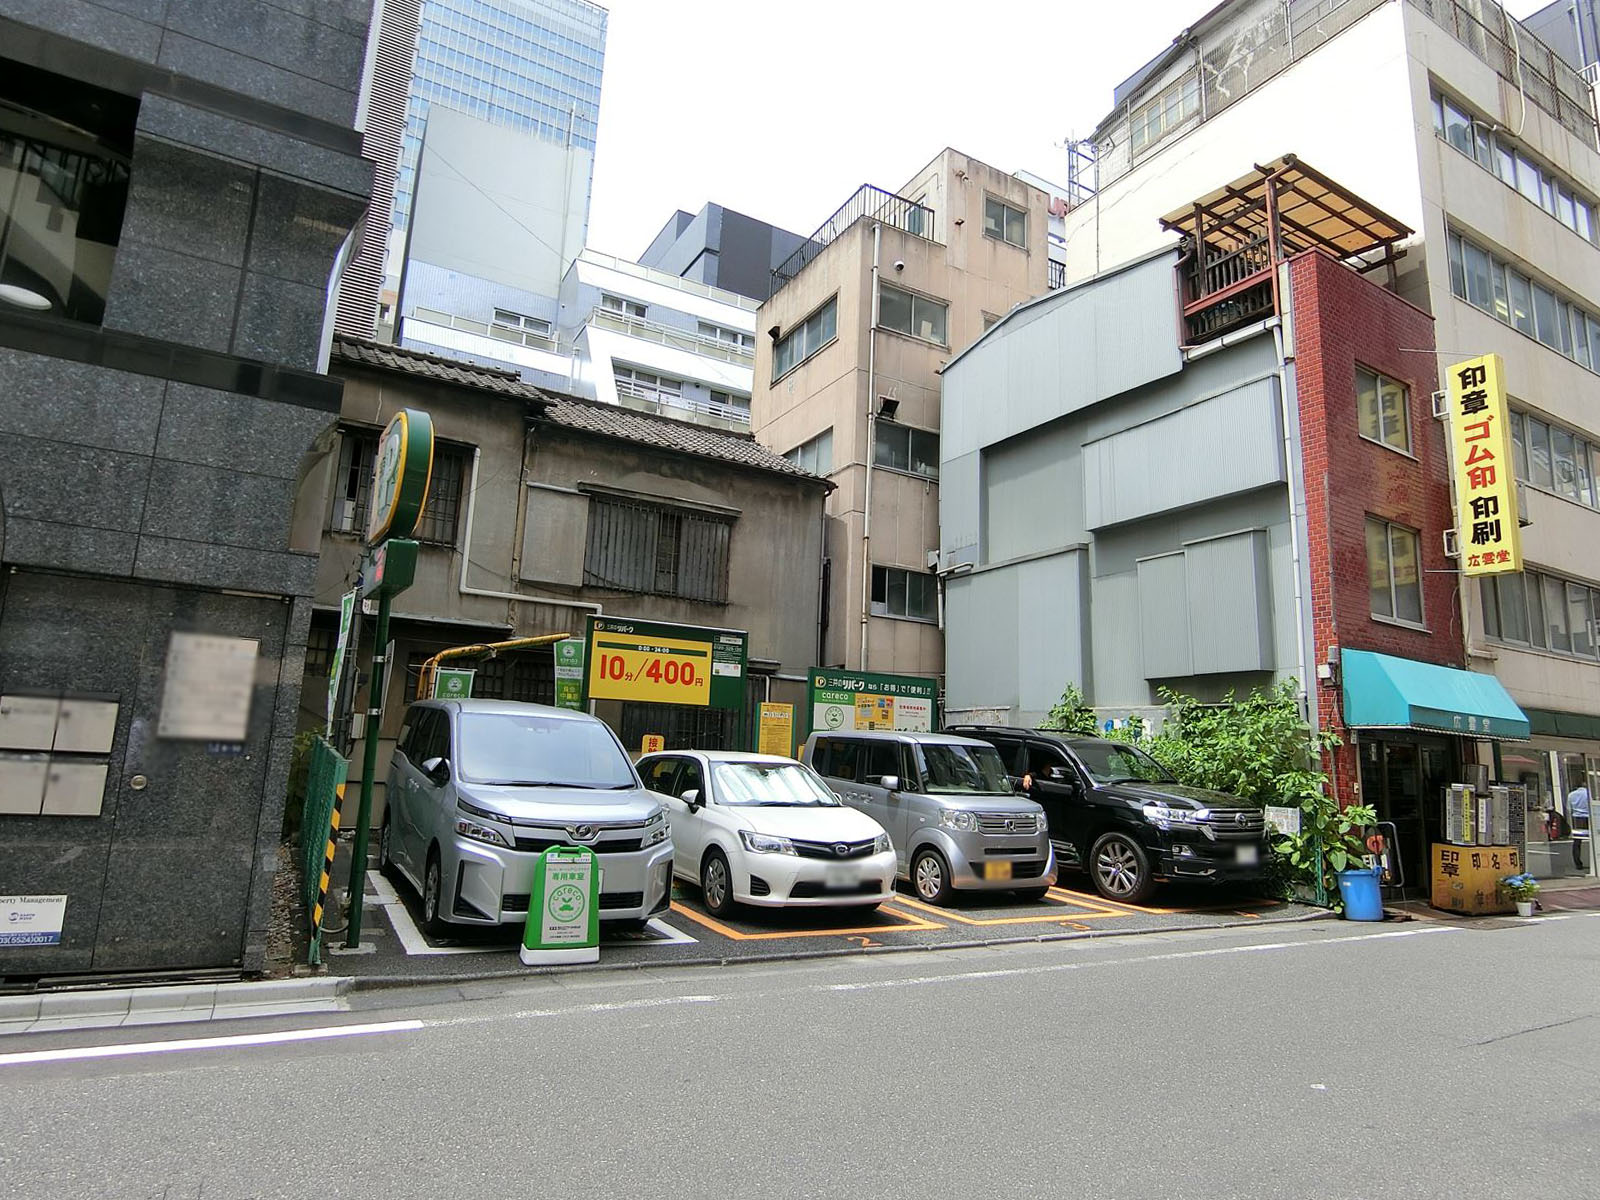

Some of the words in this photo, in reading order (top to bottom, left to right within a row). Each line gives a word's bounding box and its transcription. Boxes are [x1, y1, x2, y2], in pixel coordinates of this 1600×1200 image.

[1457, 365, 1488, 416] 印章
[1464, 414, 1496, 490] ゴム印
[1468, 495, 1501, 546] 印刷
[1467, 549, 1511, 567] 広雲堂
[822, 692, 849, 700] careco
[1441, 850, 1460, 877] 印章
[20, 896, 62, 904] Management
[553, 888, 581, 900] careco
[847, 936, 883, 946] 2
